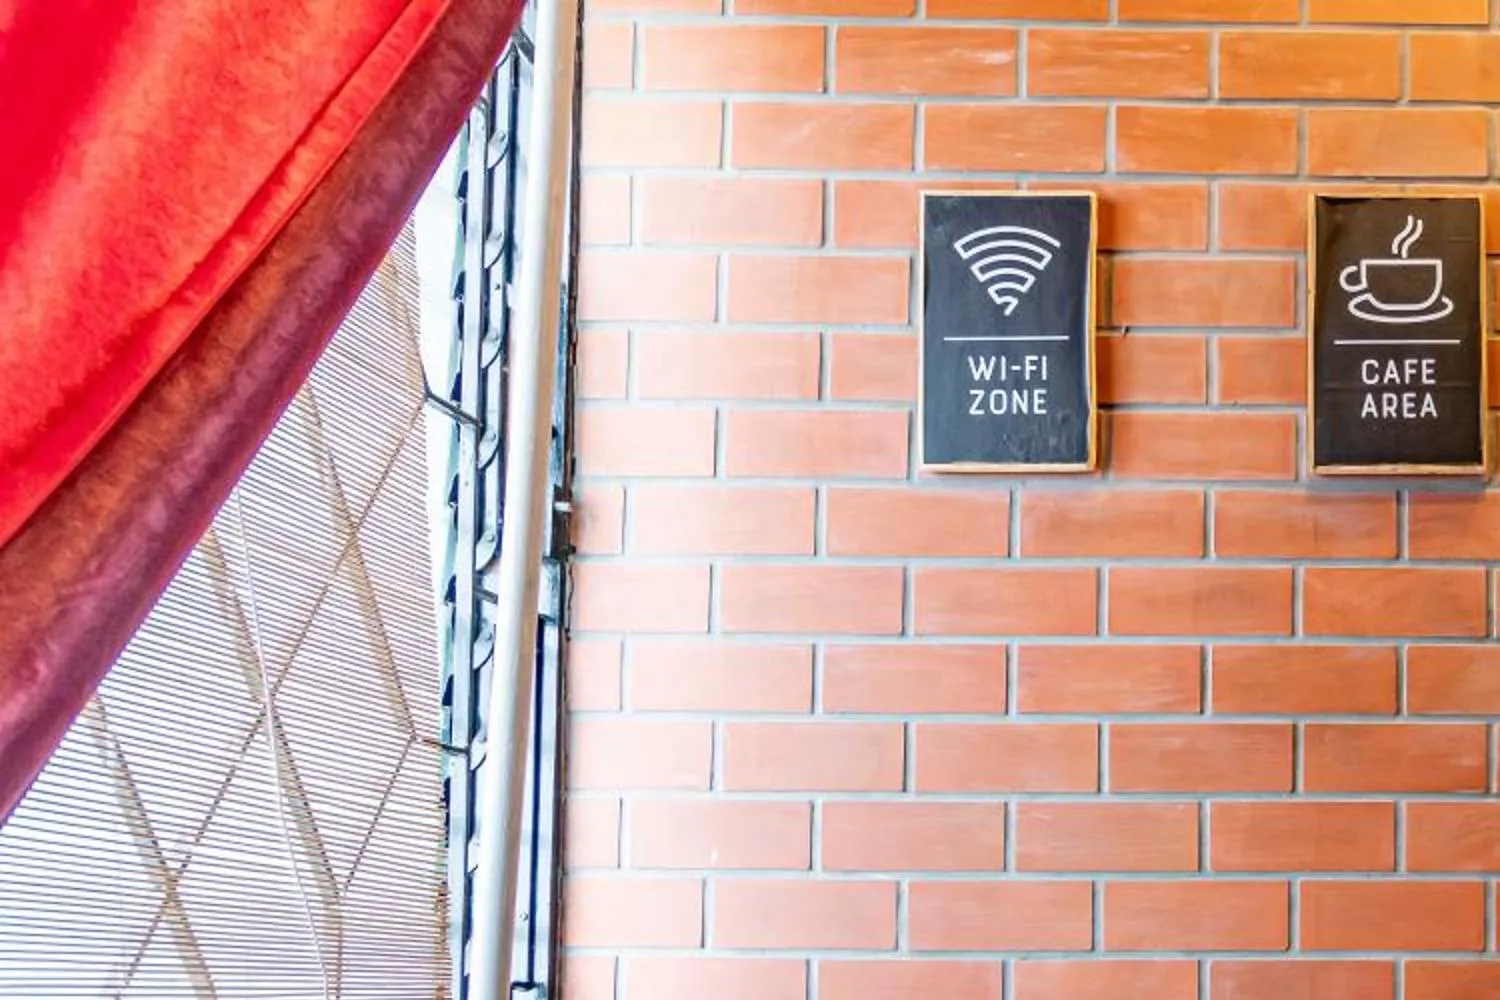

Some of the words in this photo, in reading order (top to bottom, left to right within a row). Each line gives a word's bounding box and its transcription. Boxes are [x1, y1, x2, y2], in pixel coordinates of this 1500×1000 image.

[967, 355, 1048, 382] WI-FI
[1361, 358, 1436, 385] CAFE
[967, 388, 1048, 417] ZONE
[1361, 392, 1438, 419] AREA
